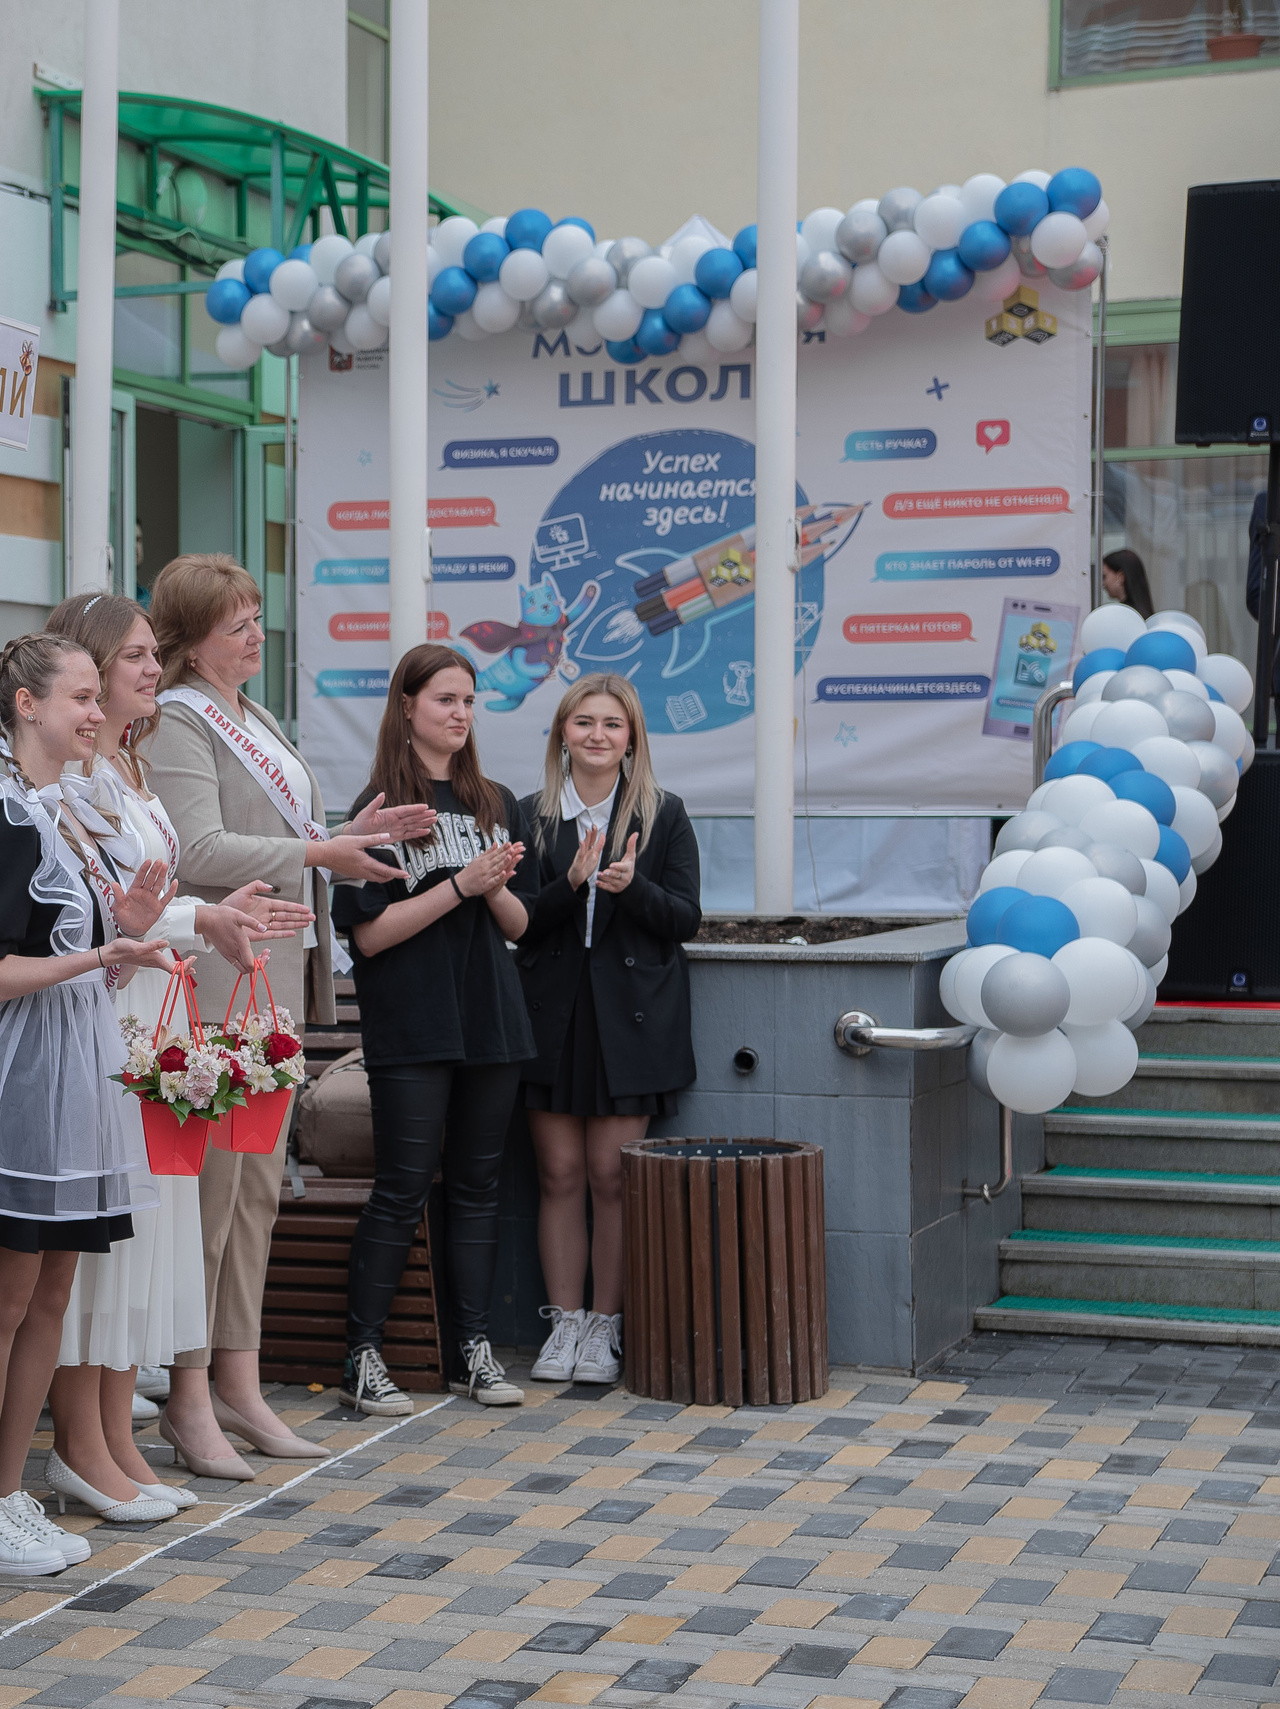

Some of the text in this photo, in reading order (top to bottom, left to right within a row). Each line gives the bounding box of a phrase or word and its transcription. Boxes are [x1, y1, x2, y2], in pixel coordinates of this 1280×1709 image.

[559, 364, 751, 408] ШКОЛ
[855, 438, 928, 451] ЕСТЬ РУЧКА?
[452, 446, 555, 460] ФИЗИКА, Я СКУЧАЛ!
[642, 449, 721, 475] Успех
[943, 497, 982, 508] НИКТО
[984, 496, 1001, 507] НЕ
[1003, 494, 1063, 506] ОТМЕНЯЛ!
[336, 508, 369, 521] КОГДА
[642, 499, 728, 536] здесь!
[431, 564, 468, 575] ОПАДУ
[469, 563, 477, 573] В
[885, 561, 907, 571] КТО
[909, 559, 945, 570] ЗНАЕТ
[947, 558, 996, 569] ПАРОЛЬ
[998, 557, 1014, 568] ОТ
[346, 621, 389, 632] КАНИКУ
[850, 621, 962, 634] К ПЯТЕРКАМ ГОТОВ!
[203, 704, 301, 814] ВЫПУСКНИК
